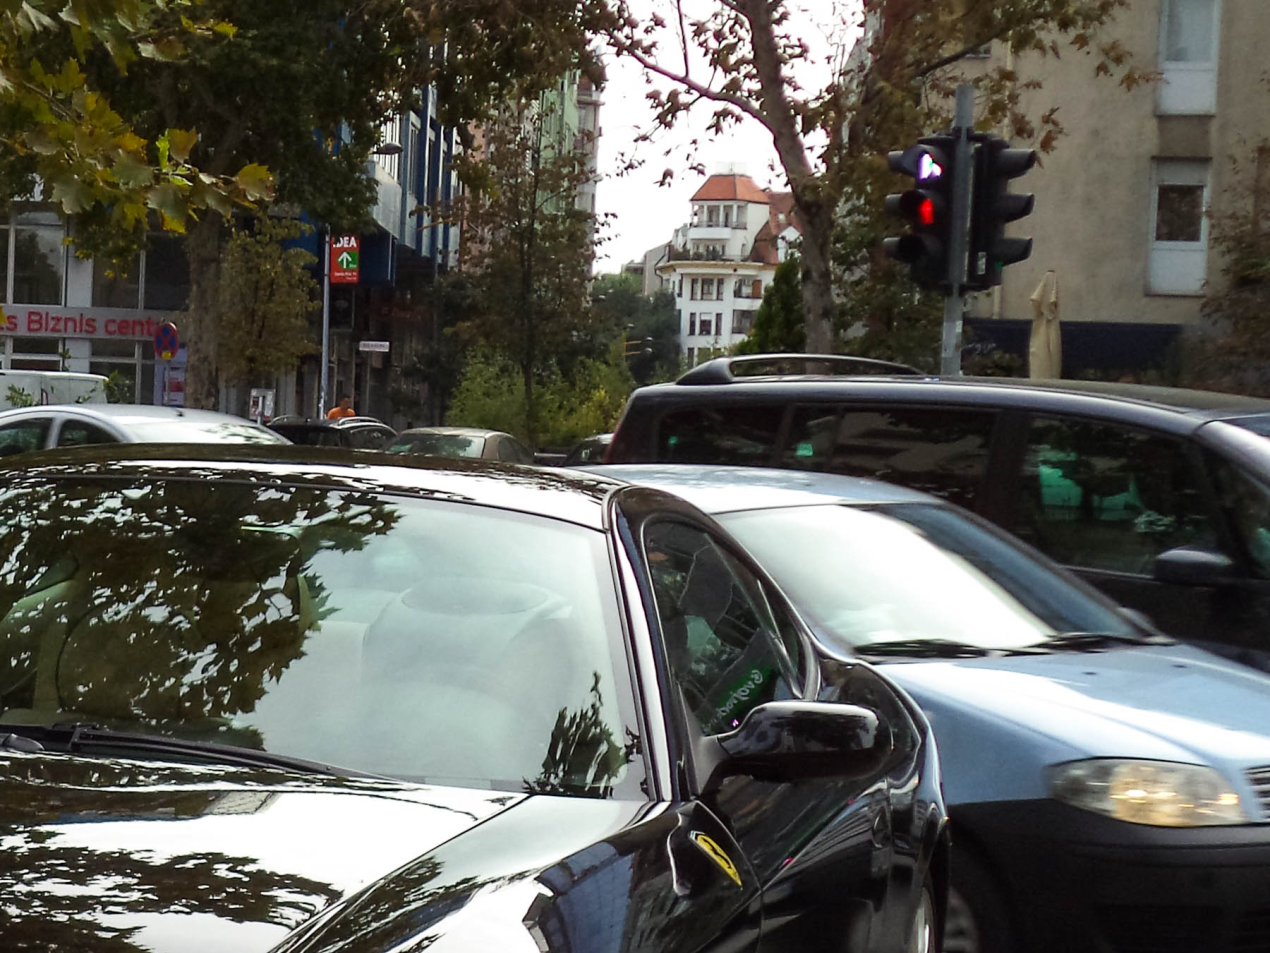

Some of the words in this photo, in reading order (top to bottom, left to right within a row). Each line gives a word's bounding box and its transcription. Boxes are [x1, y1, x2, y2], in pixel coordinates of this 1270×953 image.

[332, 236, 357, 248] DEA
[27, 310, 97, 334] Biznis
[105, 316, 159, 335] cent
